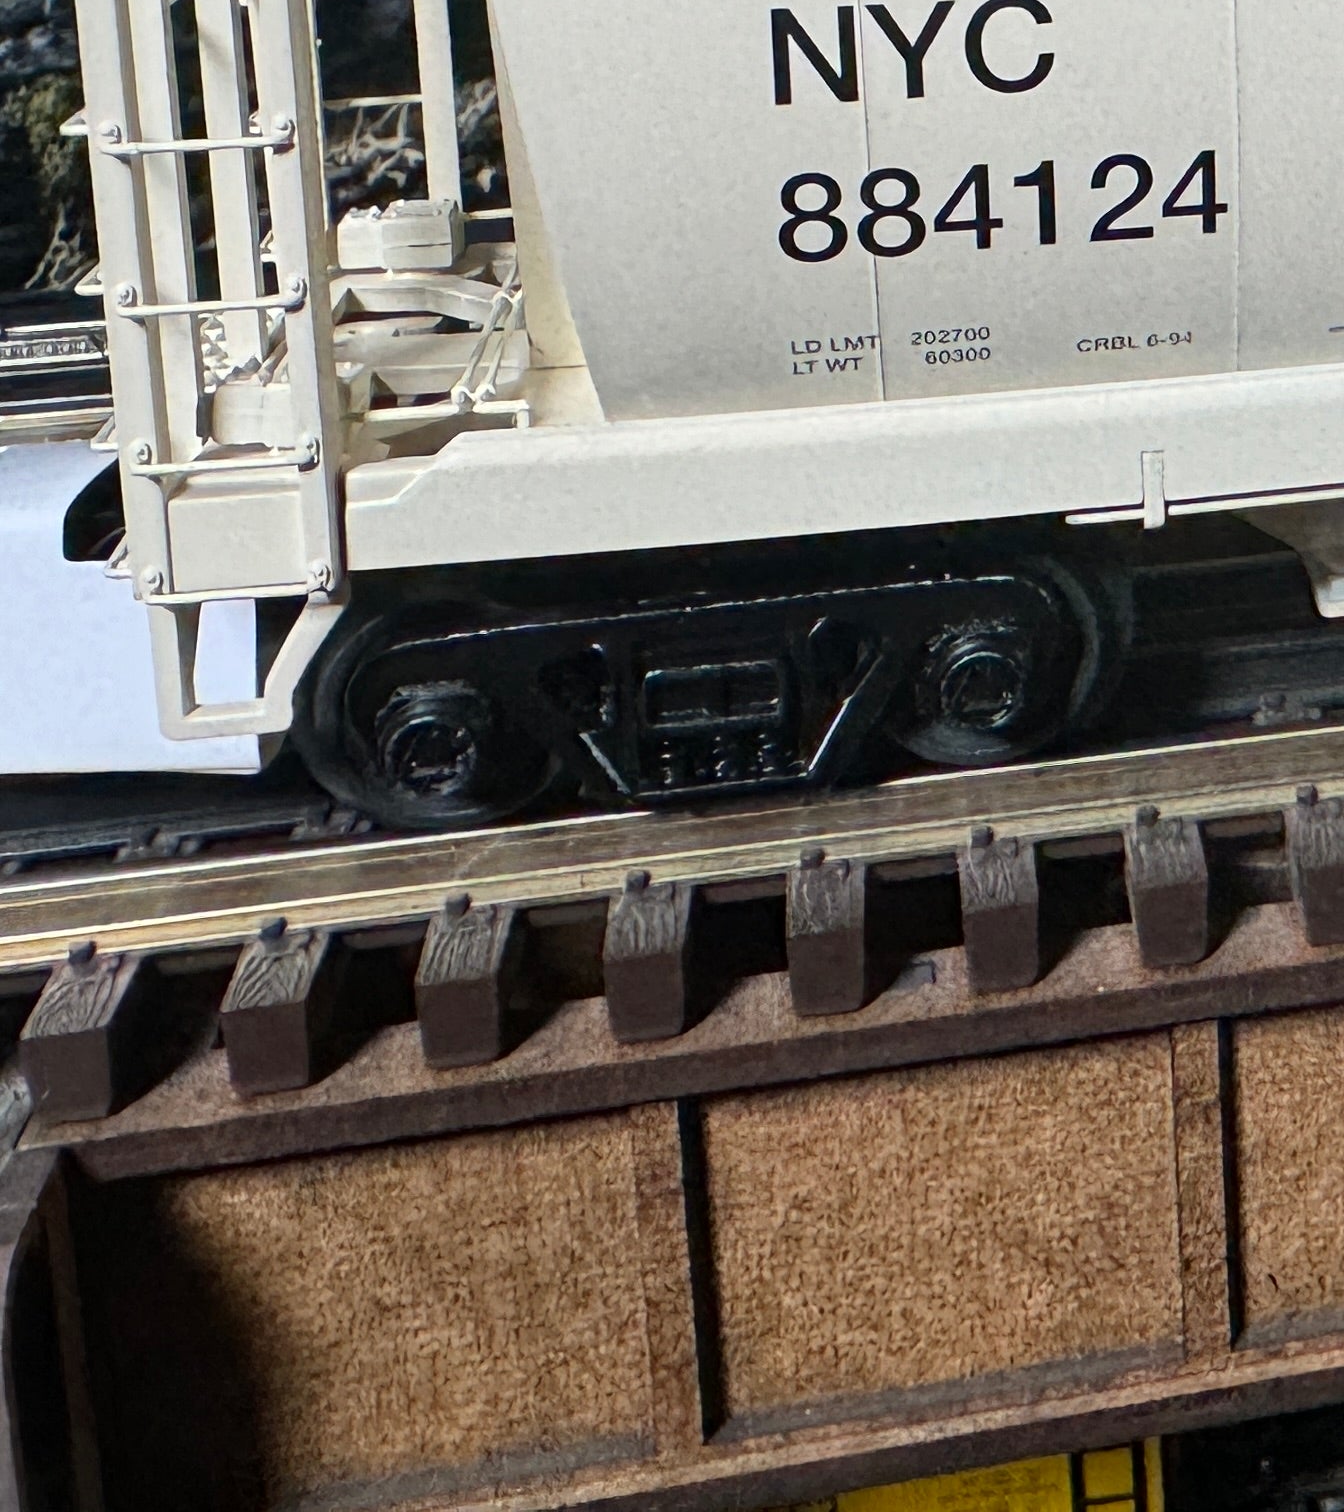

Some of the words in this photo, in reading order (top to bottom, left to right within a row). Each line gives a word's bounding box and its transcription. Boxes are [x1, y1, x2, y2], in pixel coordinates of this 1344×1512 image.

[778, 149, 1228, 263] 884124
[790, 340, 822, 355] LD
[830, 335, 880, 353] LMT
[910, 326, 991, 346] 202700
[792, 359, 820, 375] LT
[825, 356, 864, 373] WT
[924, 347, 992, 365] 60300
